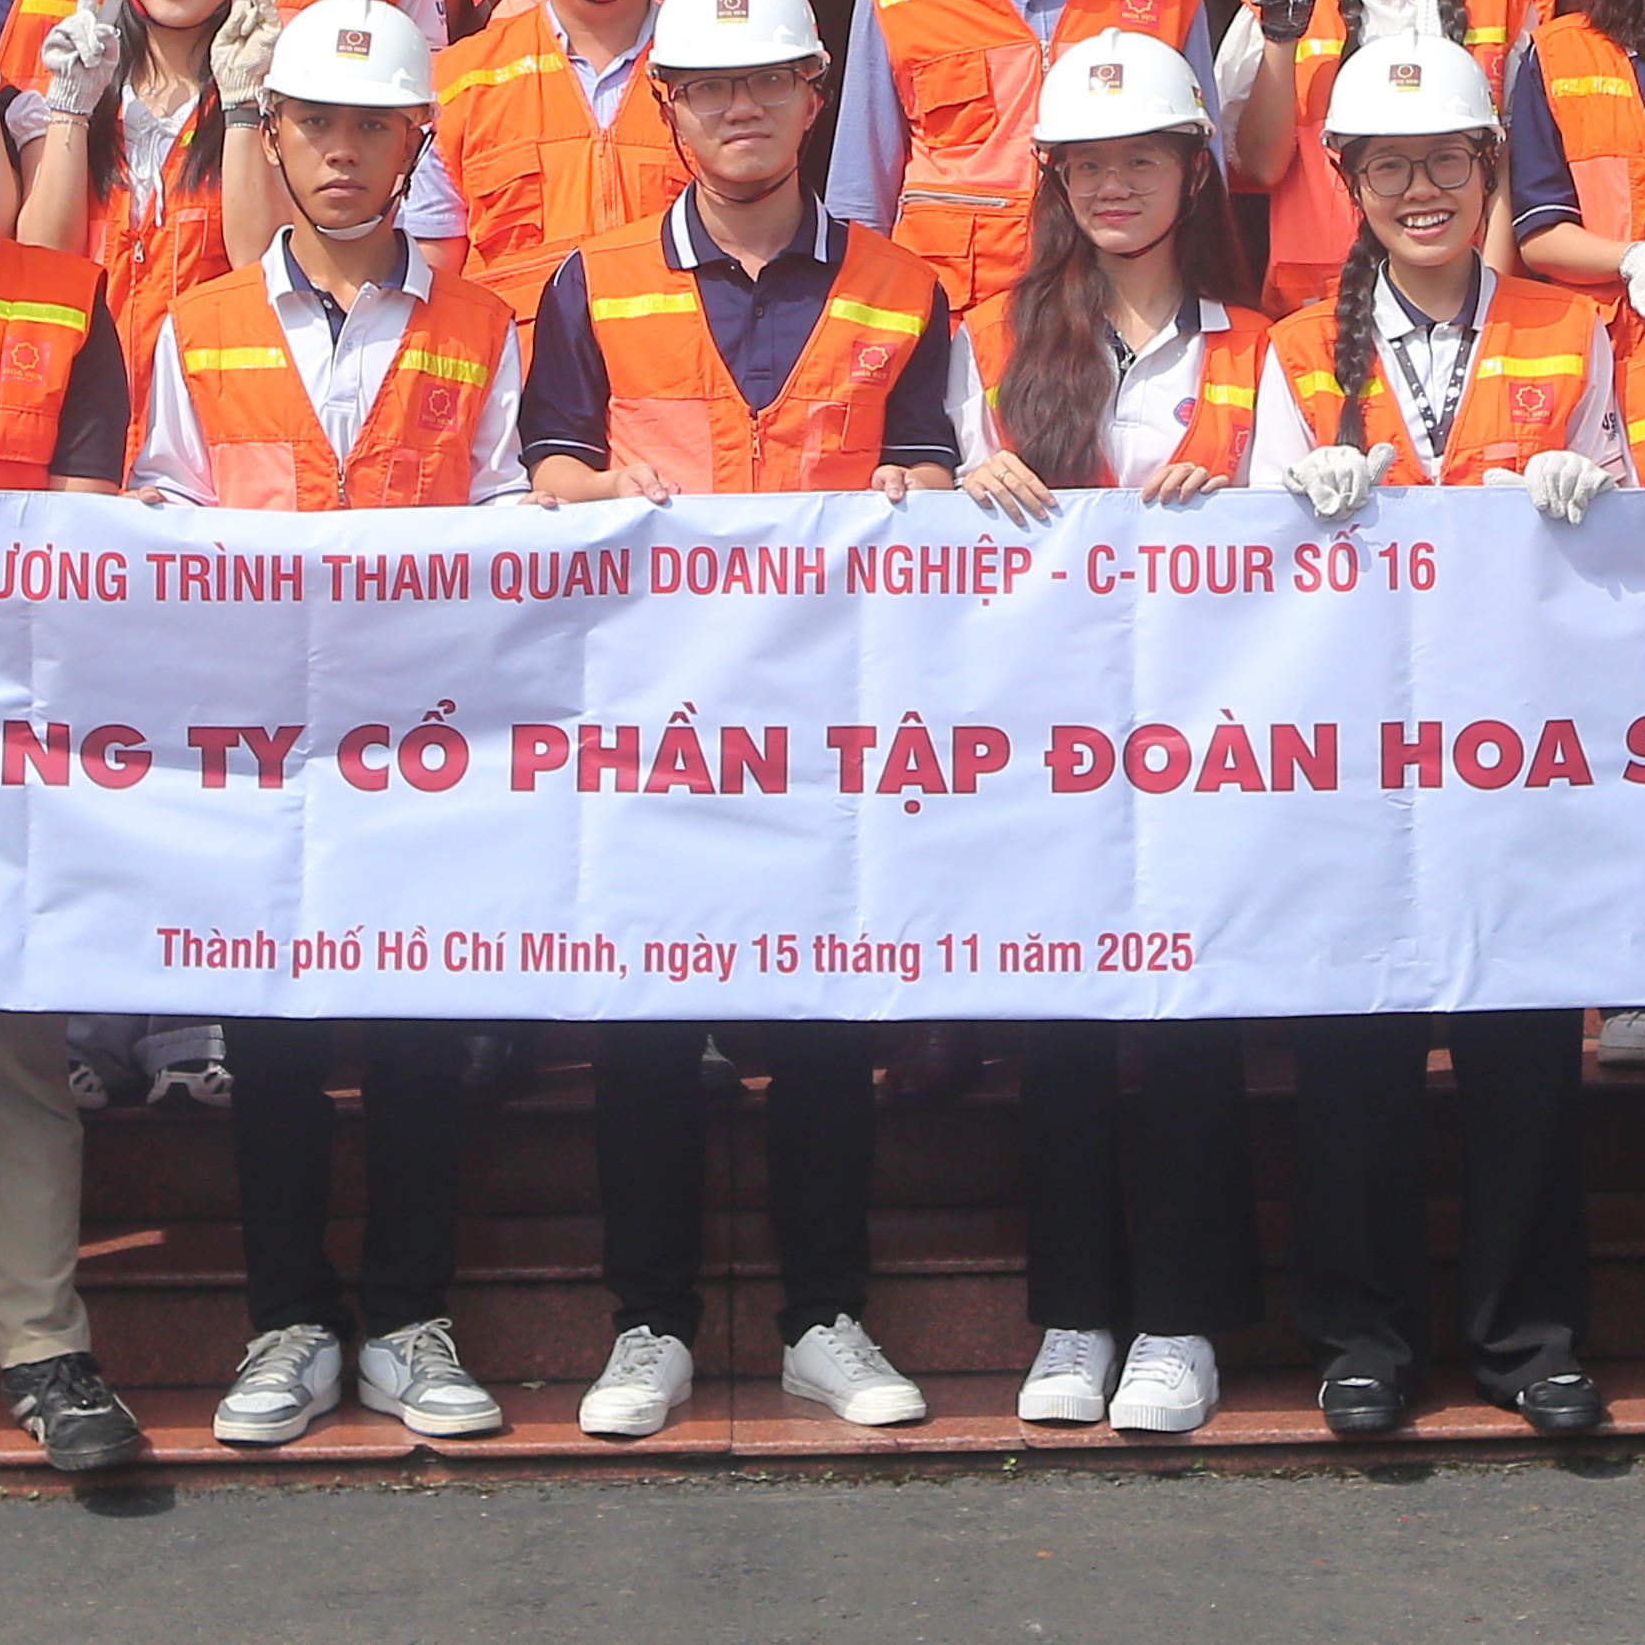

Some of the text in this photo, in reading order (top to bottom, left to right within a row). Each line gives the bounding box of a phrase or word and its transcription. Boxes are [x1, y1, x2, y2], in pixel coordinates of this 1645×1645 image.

[146, 541, 304, 603] TRÌNH
[321, 552, 471, 602] THAM
[489, 547, 632, 604] QUAN
[649, 544, 828, 596] DOANH
[846, 534, 1034, 607] NGHIỆP
[1086, 542, 1276, 596] C-TOUR
[1292, 523, 1361, 594] SỐ
[1378, 540, 1438, 593] 16
[187, 724, 305, 791] TY
[337, 698, 471, 794] CỔ
[509, 700, 790, 796] PHẦN
[826, 710, 1012, 816] TẬP
[1043, 708, 1340, 796] ĐOÀN
[1379, 718, 1595, 791] HOA
[156, 923, 1195, 983] Thành phố Hồ Chí Minh, ngày 15 tháng 11 năm 2025
